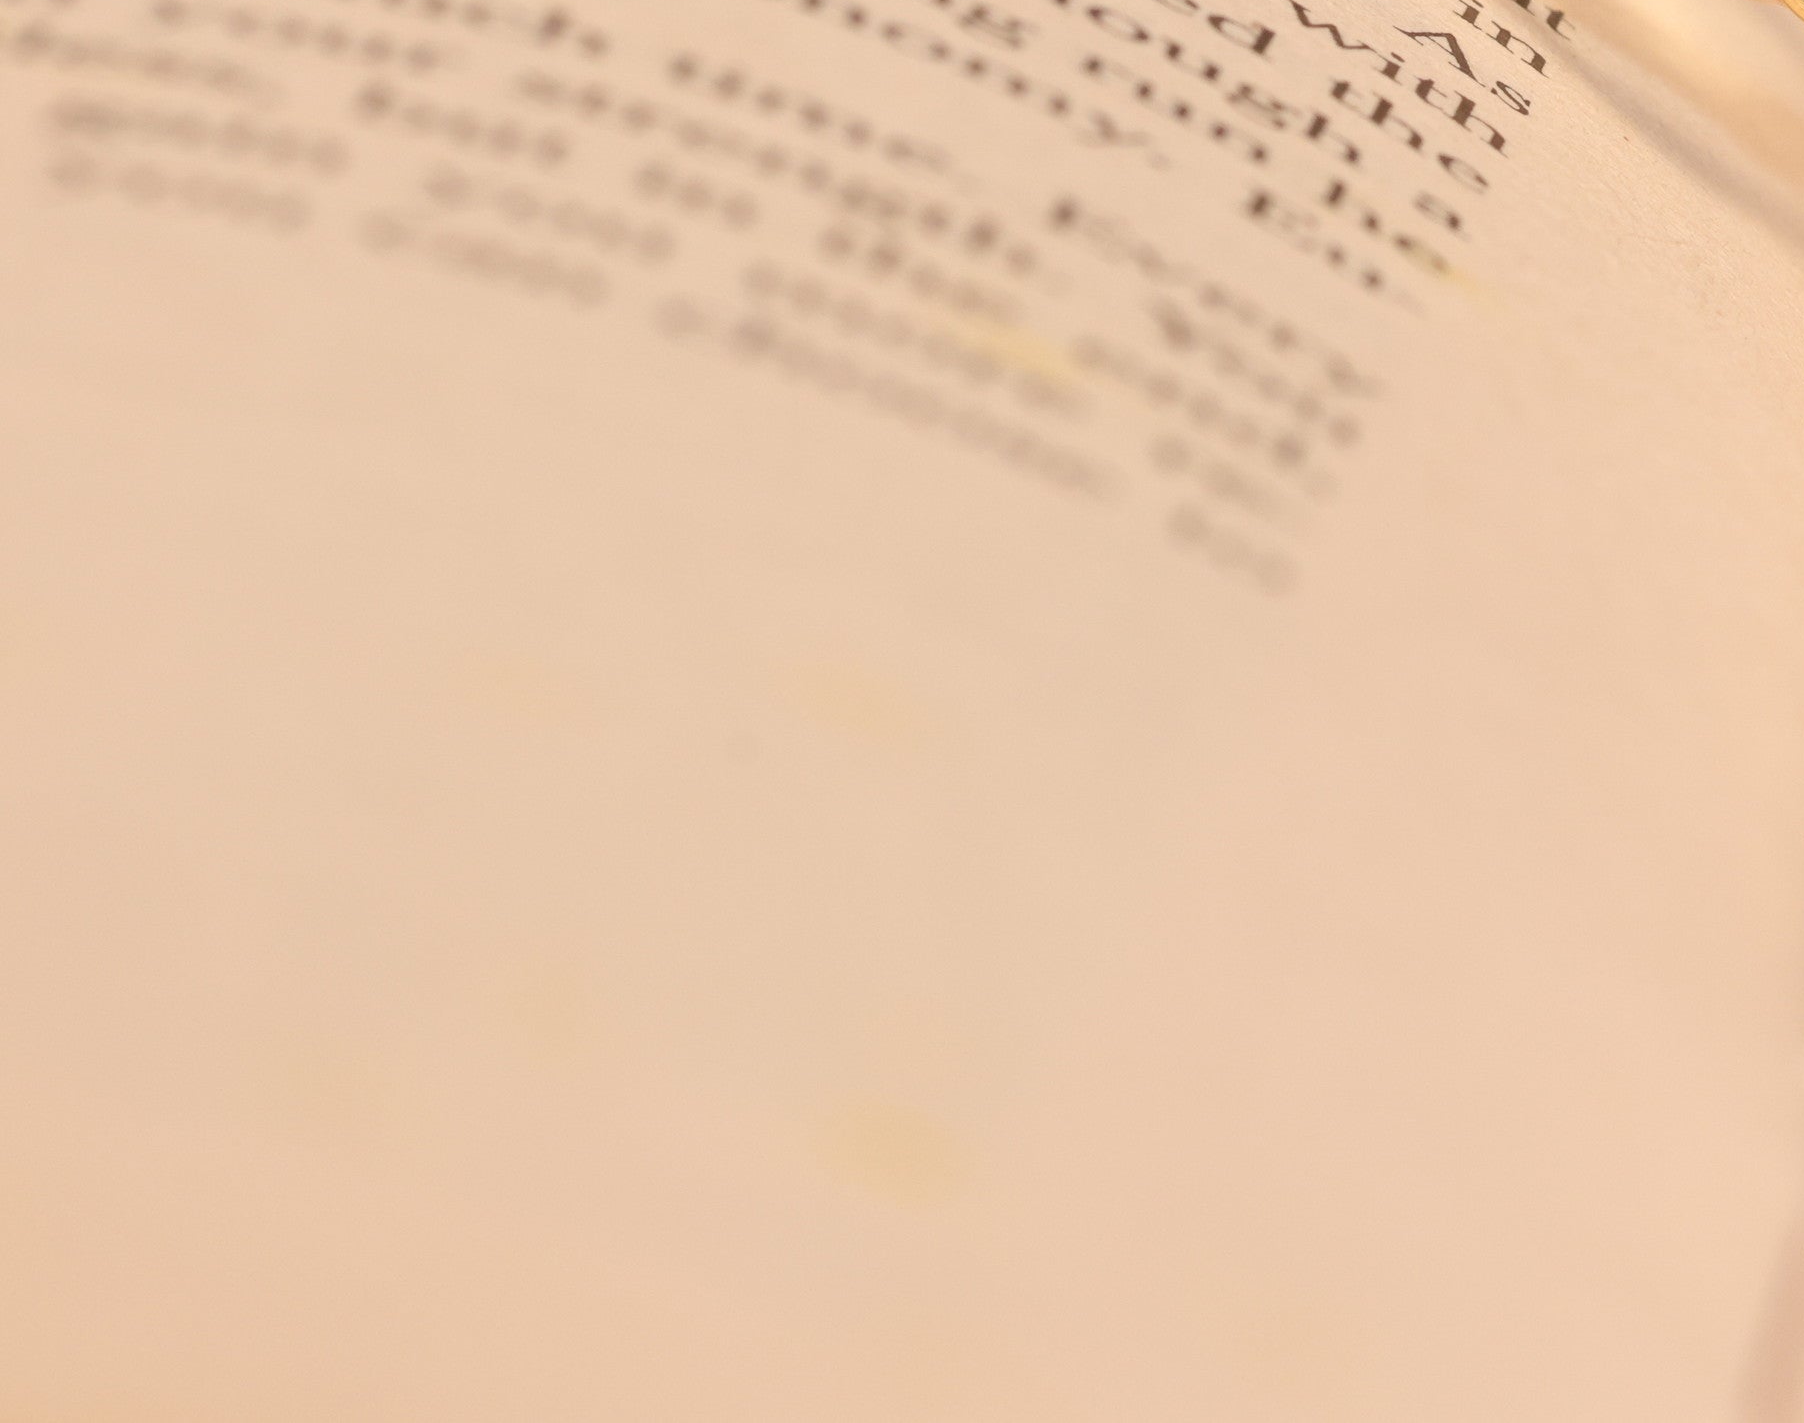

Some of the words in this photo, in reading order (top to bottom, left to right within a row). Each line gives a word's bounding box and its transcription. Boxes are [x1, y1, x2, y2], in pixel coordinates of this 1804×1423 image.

[1393, 25, 1532, 117] As
[1077, 49, 1272, 168] run
[1321, 178, 1452, 274] he
[1328, 77, 1492, 193] the
[1412, 189, 1471, 241] a
